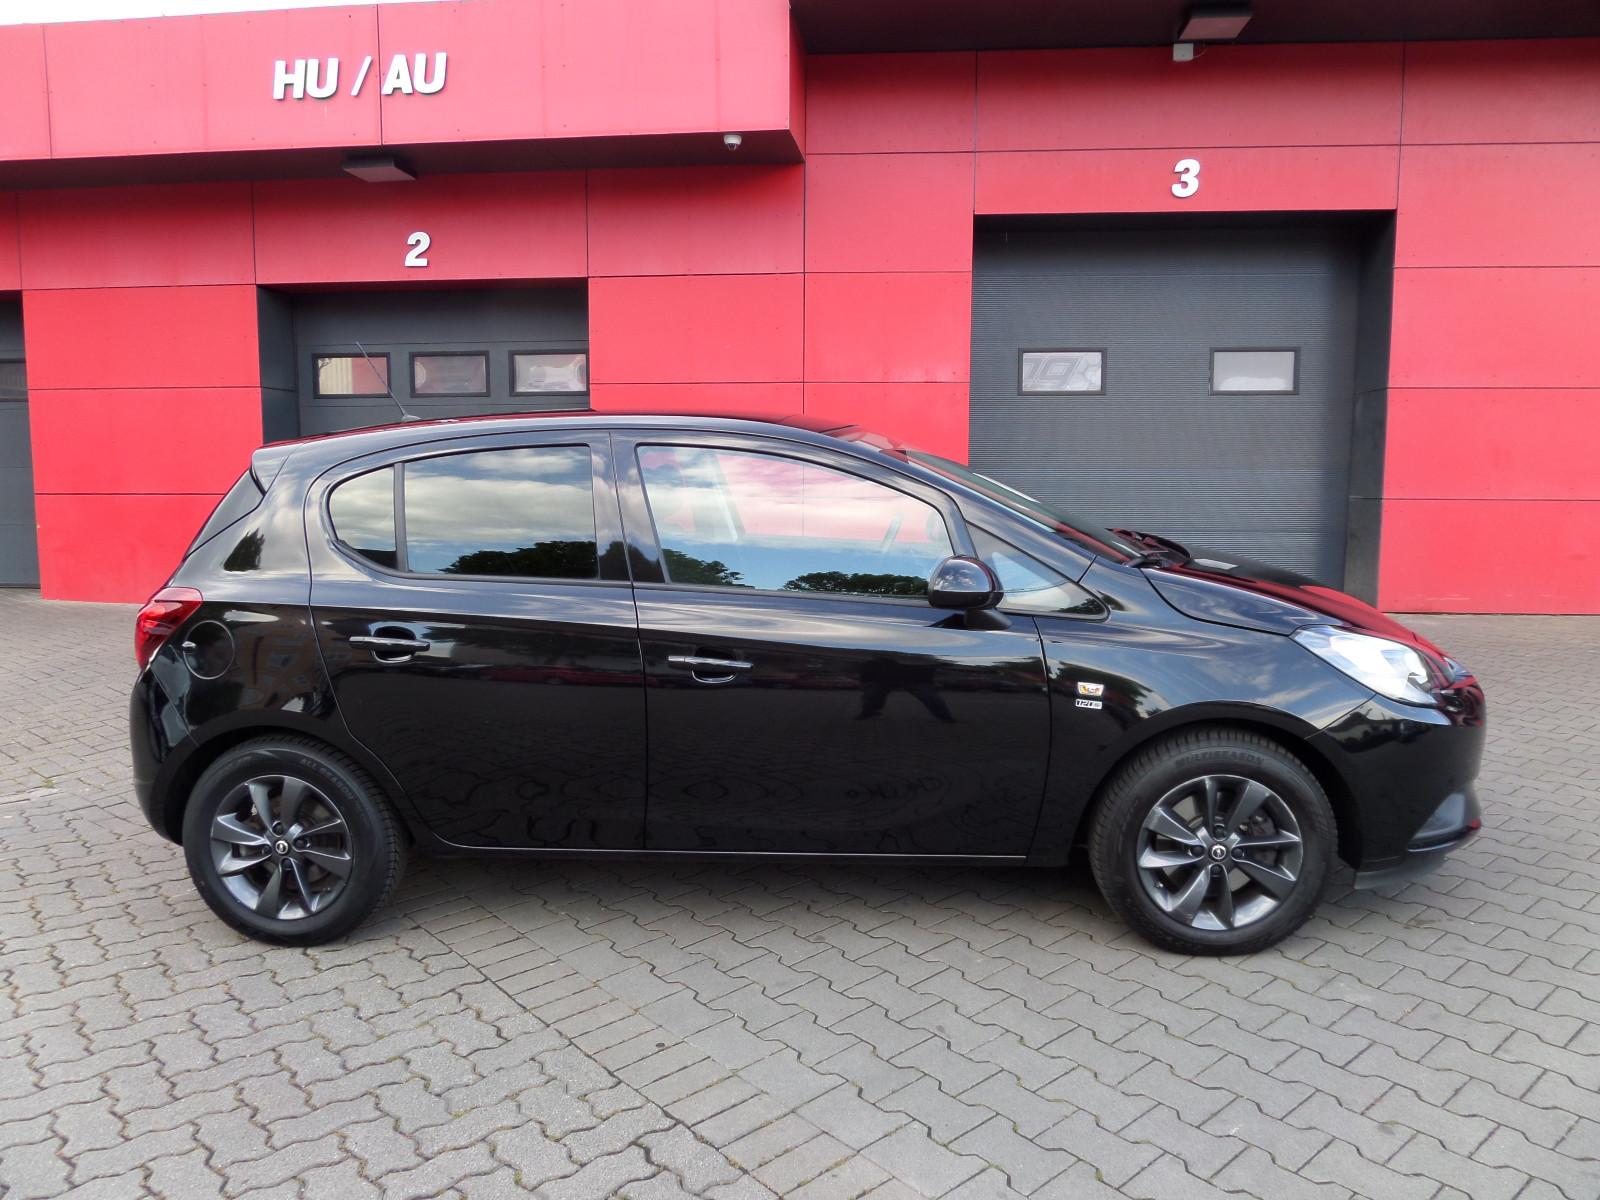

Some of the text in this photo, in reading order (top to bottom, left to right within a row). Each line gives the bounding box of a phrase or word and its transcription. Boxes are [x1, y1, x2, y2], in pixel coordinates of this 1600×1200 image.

[273, 52, 447, 99] HU / AU
[1171, 158, 1200, 198] 3
[404, 231, 430, 267] 2
